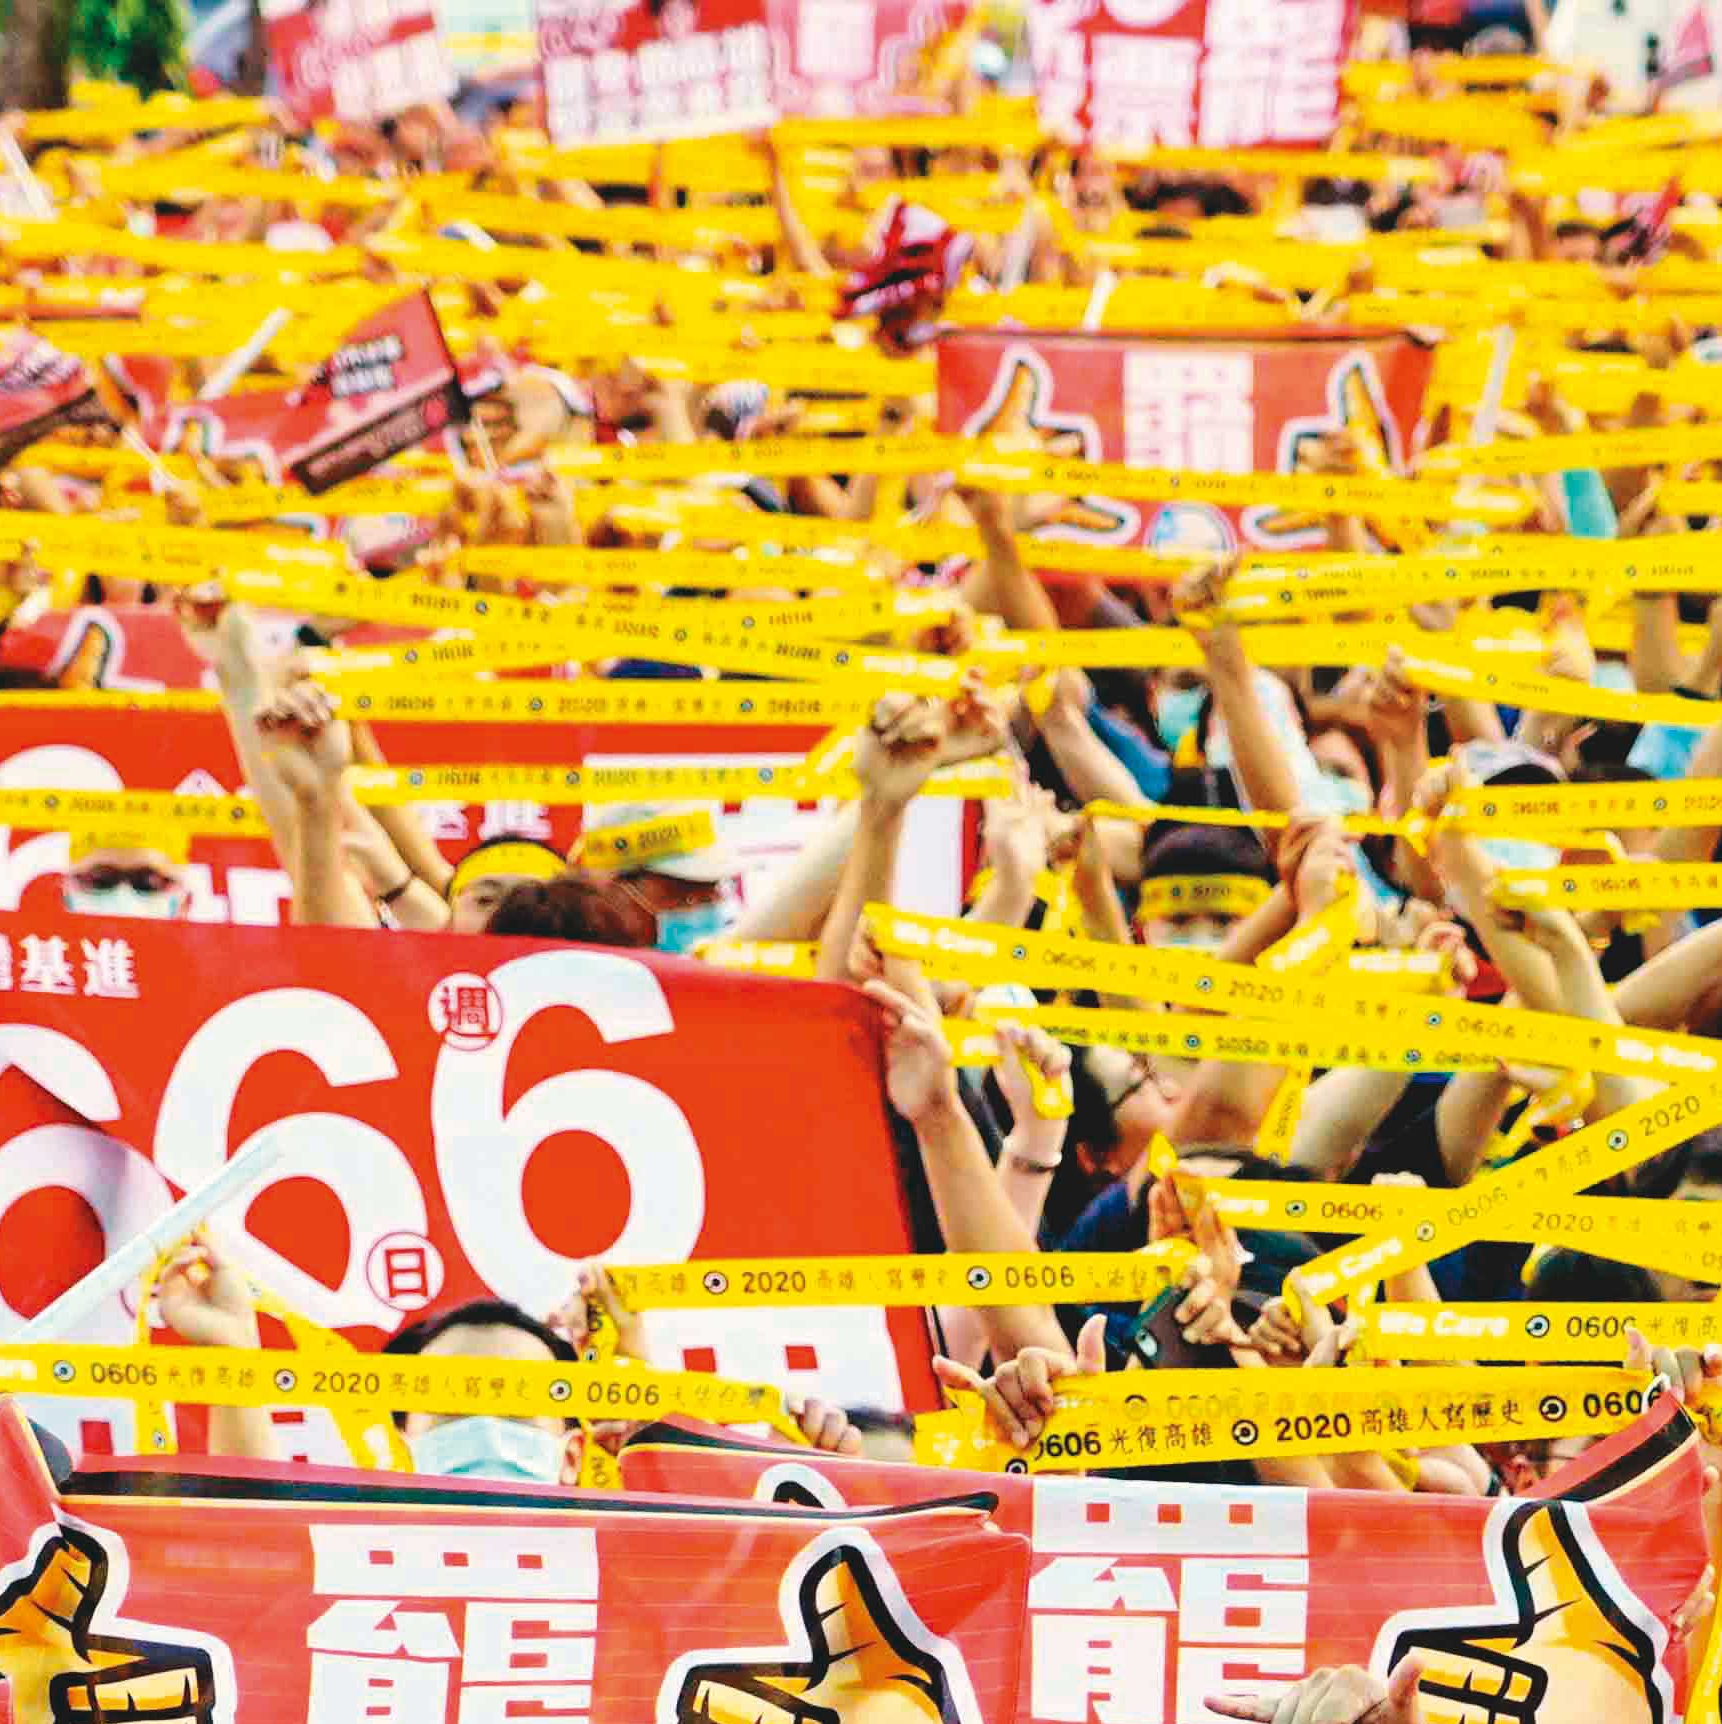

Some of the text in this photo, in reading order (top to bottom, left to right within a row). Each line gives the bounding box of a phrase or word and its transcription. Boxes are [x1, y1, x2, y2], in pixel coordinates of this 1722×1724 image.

[1639, 1096, 1702, 1139] 2020
[1321, 1200, 1383, 1220] 0606
[1530, 1211, 1595, 1232] 2020
[382, 1244, 431, 1302] 日
[740, 1267, 807, 1298] 2020
[1006, 1265, 1075, 1292] 0606
[90, 1360, 159, 1391] 0606
[311, 1367, 379, 1398] 2020
[388, 1370, 535, 1410] 高雄人寫歷史
[584, 1379, 661, 1411] 0606
[1110, 1398, 1523, 1454] 光復高雄 2020 高雄人寫歷史
